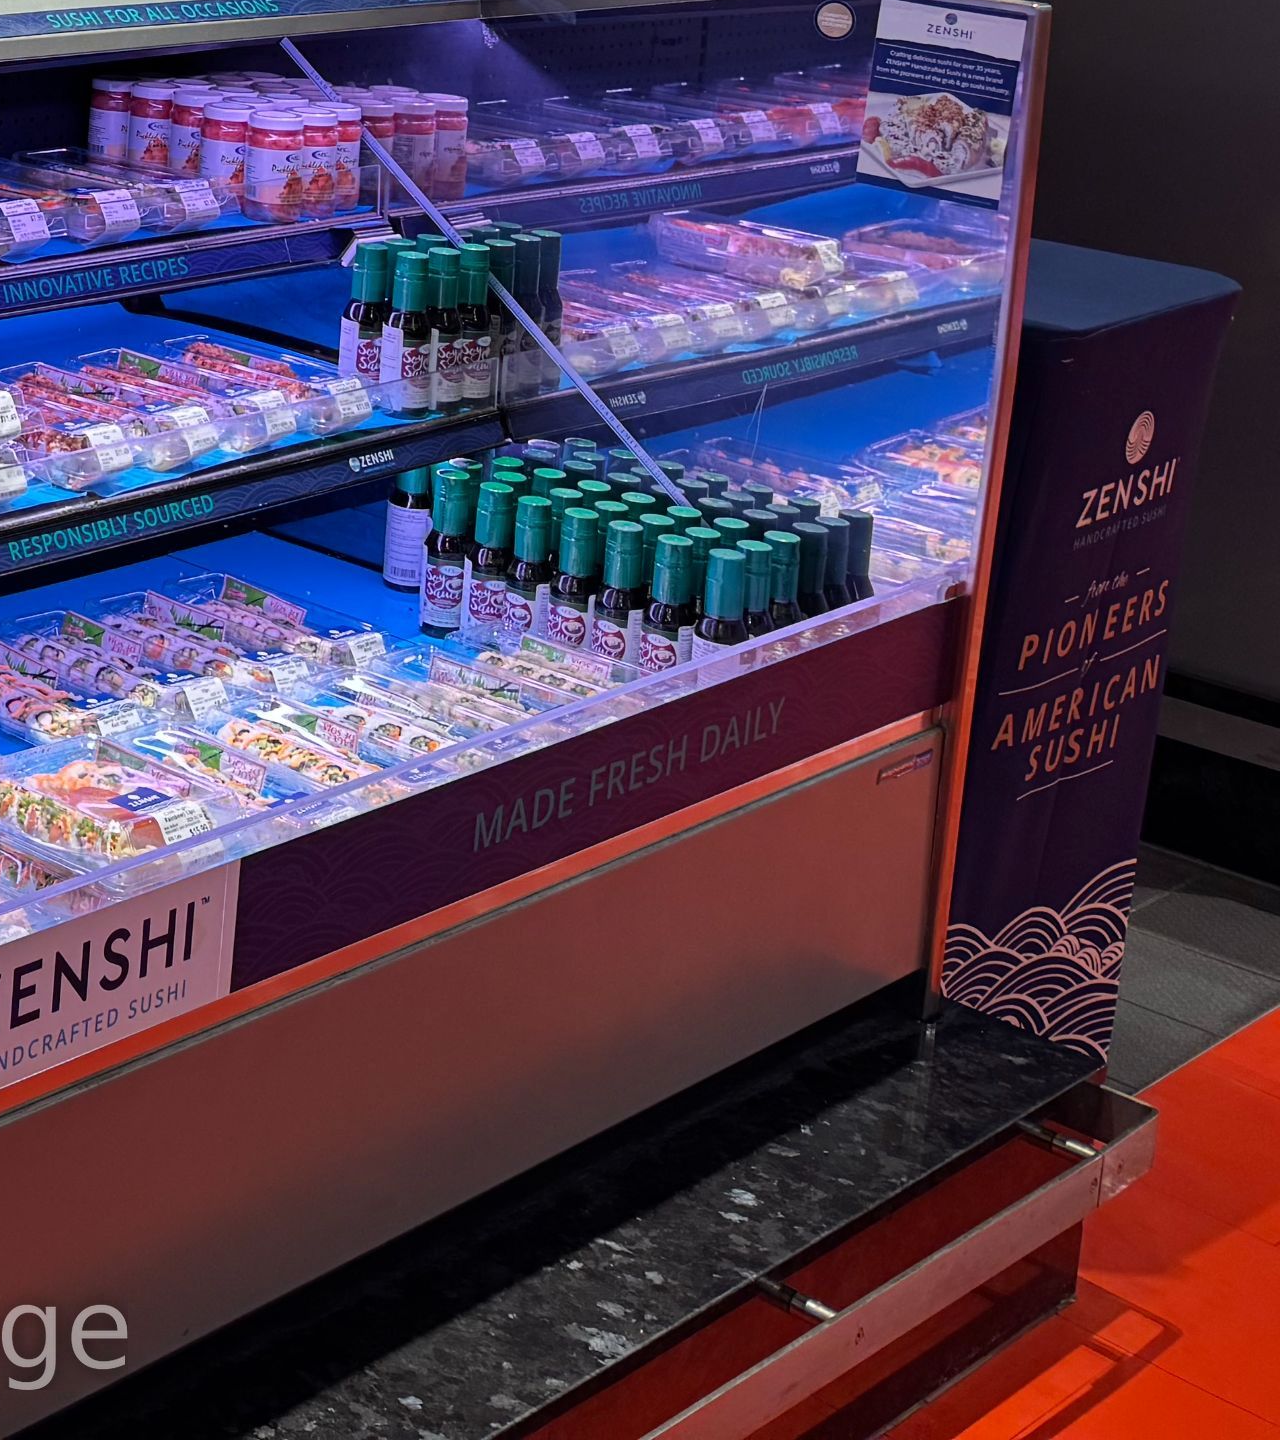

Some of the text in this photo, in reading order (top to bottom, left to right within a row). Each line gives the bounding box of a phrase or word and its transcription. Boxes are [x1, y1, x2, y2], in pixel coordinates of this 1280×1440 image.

[47, 9, 99, 30] SUSHI
[103, 7, 141, 26] FOR
[145, 3, 179, 23] ALL
[927, 24, 973, 40] ZENSHI
[2, 258, 189, 304] INNOVATIVE RECIPES
[359, 448, 394, 468] ZENSHI
[1075, 457, 1177, 529] ZENSHI
[8, 495, 215, 561] RESPONSIBLY SOURCED
[1073, 504, 1167, 551] HANDCRAFTED SUSHI
[1018, 579, 1168, 671] PIONEERS
[991, 655, 1160, 751] AMERICAN
[473, 697, 786, 852] MADE FRESH DAILY
[1025, 713, 1119, 782] SUSHI
[129, 979, 188, 1020] SUSHI
